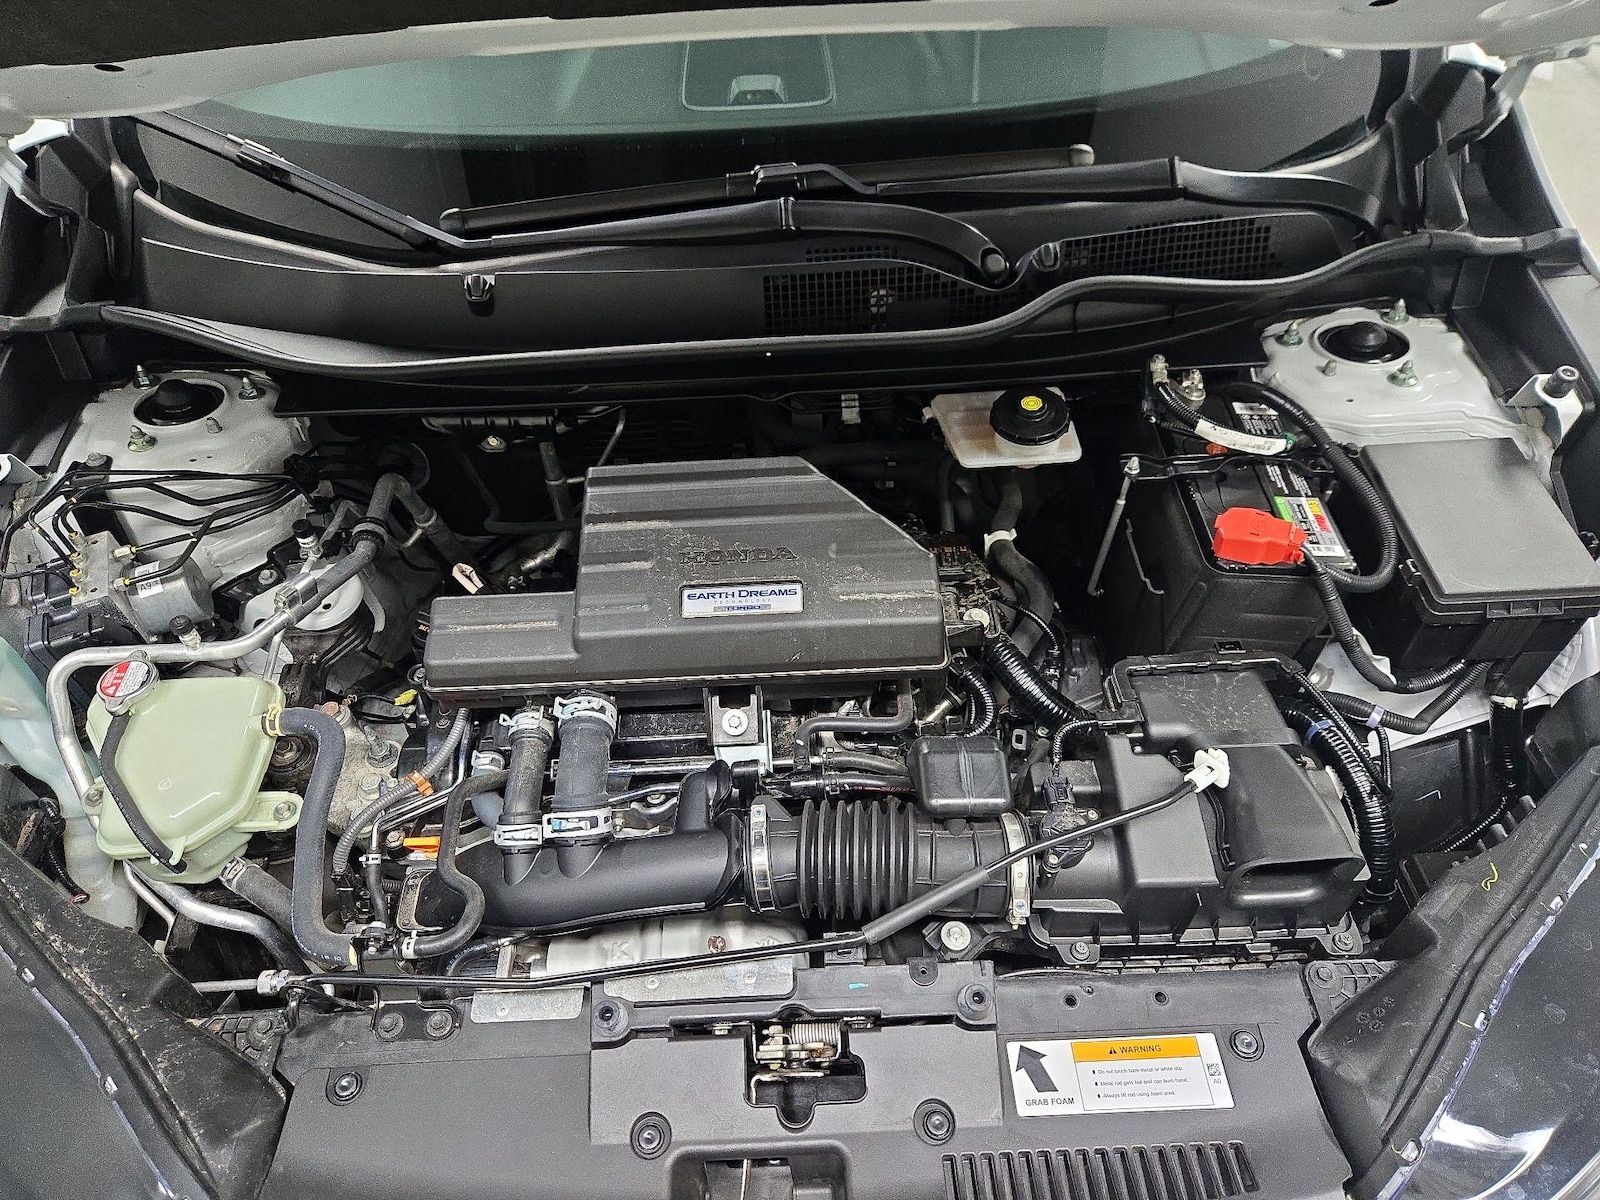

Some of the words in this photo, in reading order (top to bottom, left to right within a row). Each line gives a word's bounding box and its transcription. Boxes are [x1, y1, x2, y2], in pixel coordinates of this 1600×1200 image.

[679, 546, 799, 565] HONDA
[686, 591, 735, 601] EARTH
[738, 588, 798, 598] DREAMS
[1119, 1044, 1162, 1054] WARNING
[1025, 1098, 1049, 1107] GRAB
[1051, 1097, 1075, 1106] FOAM
